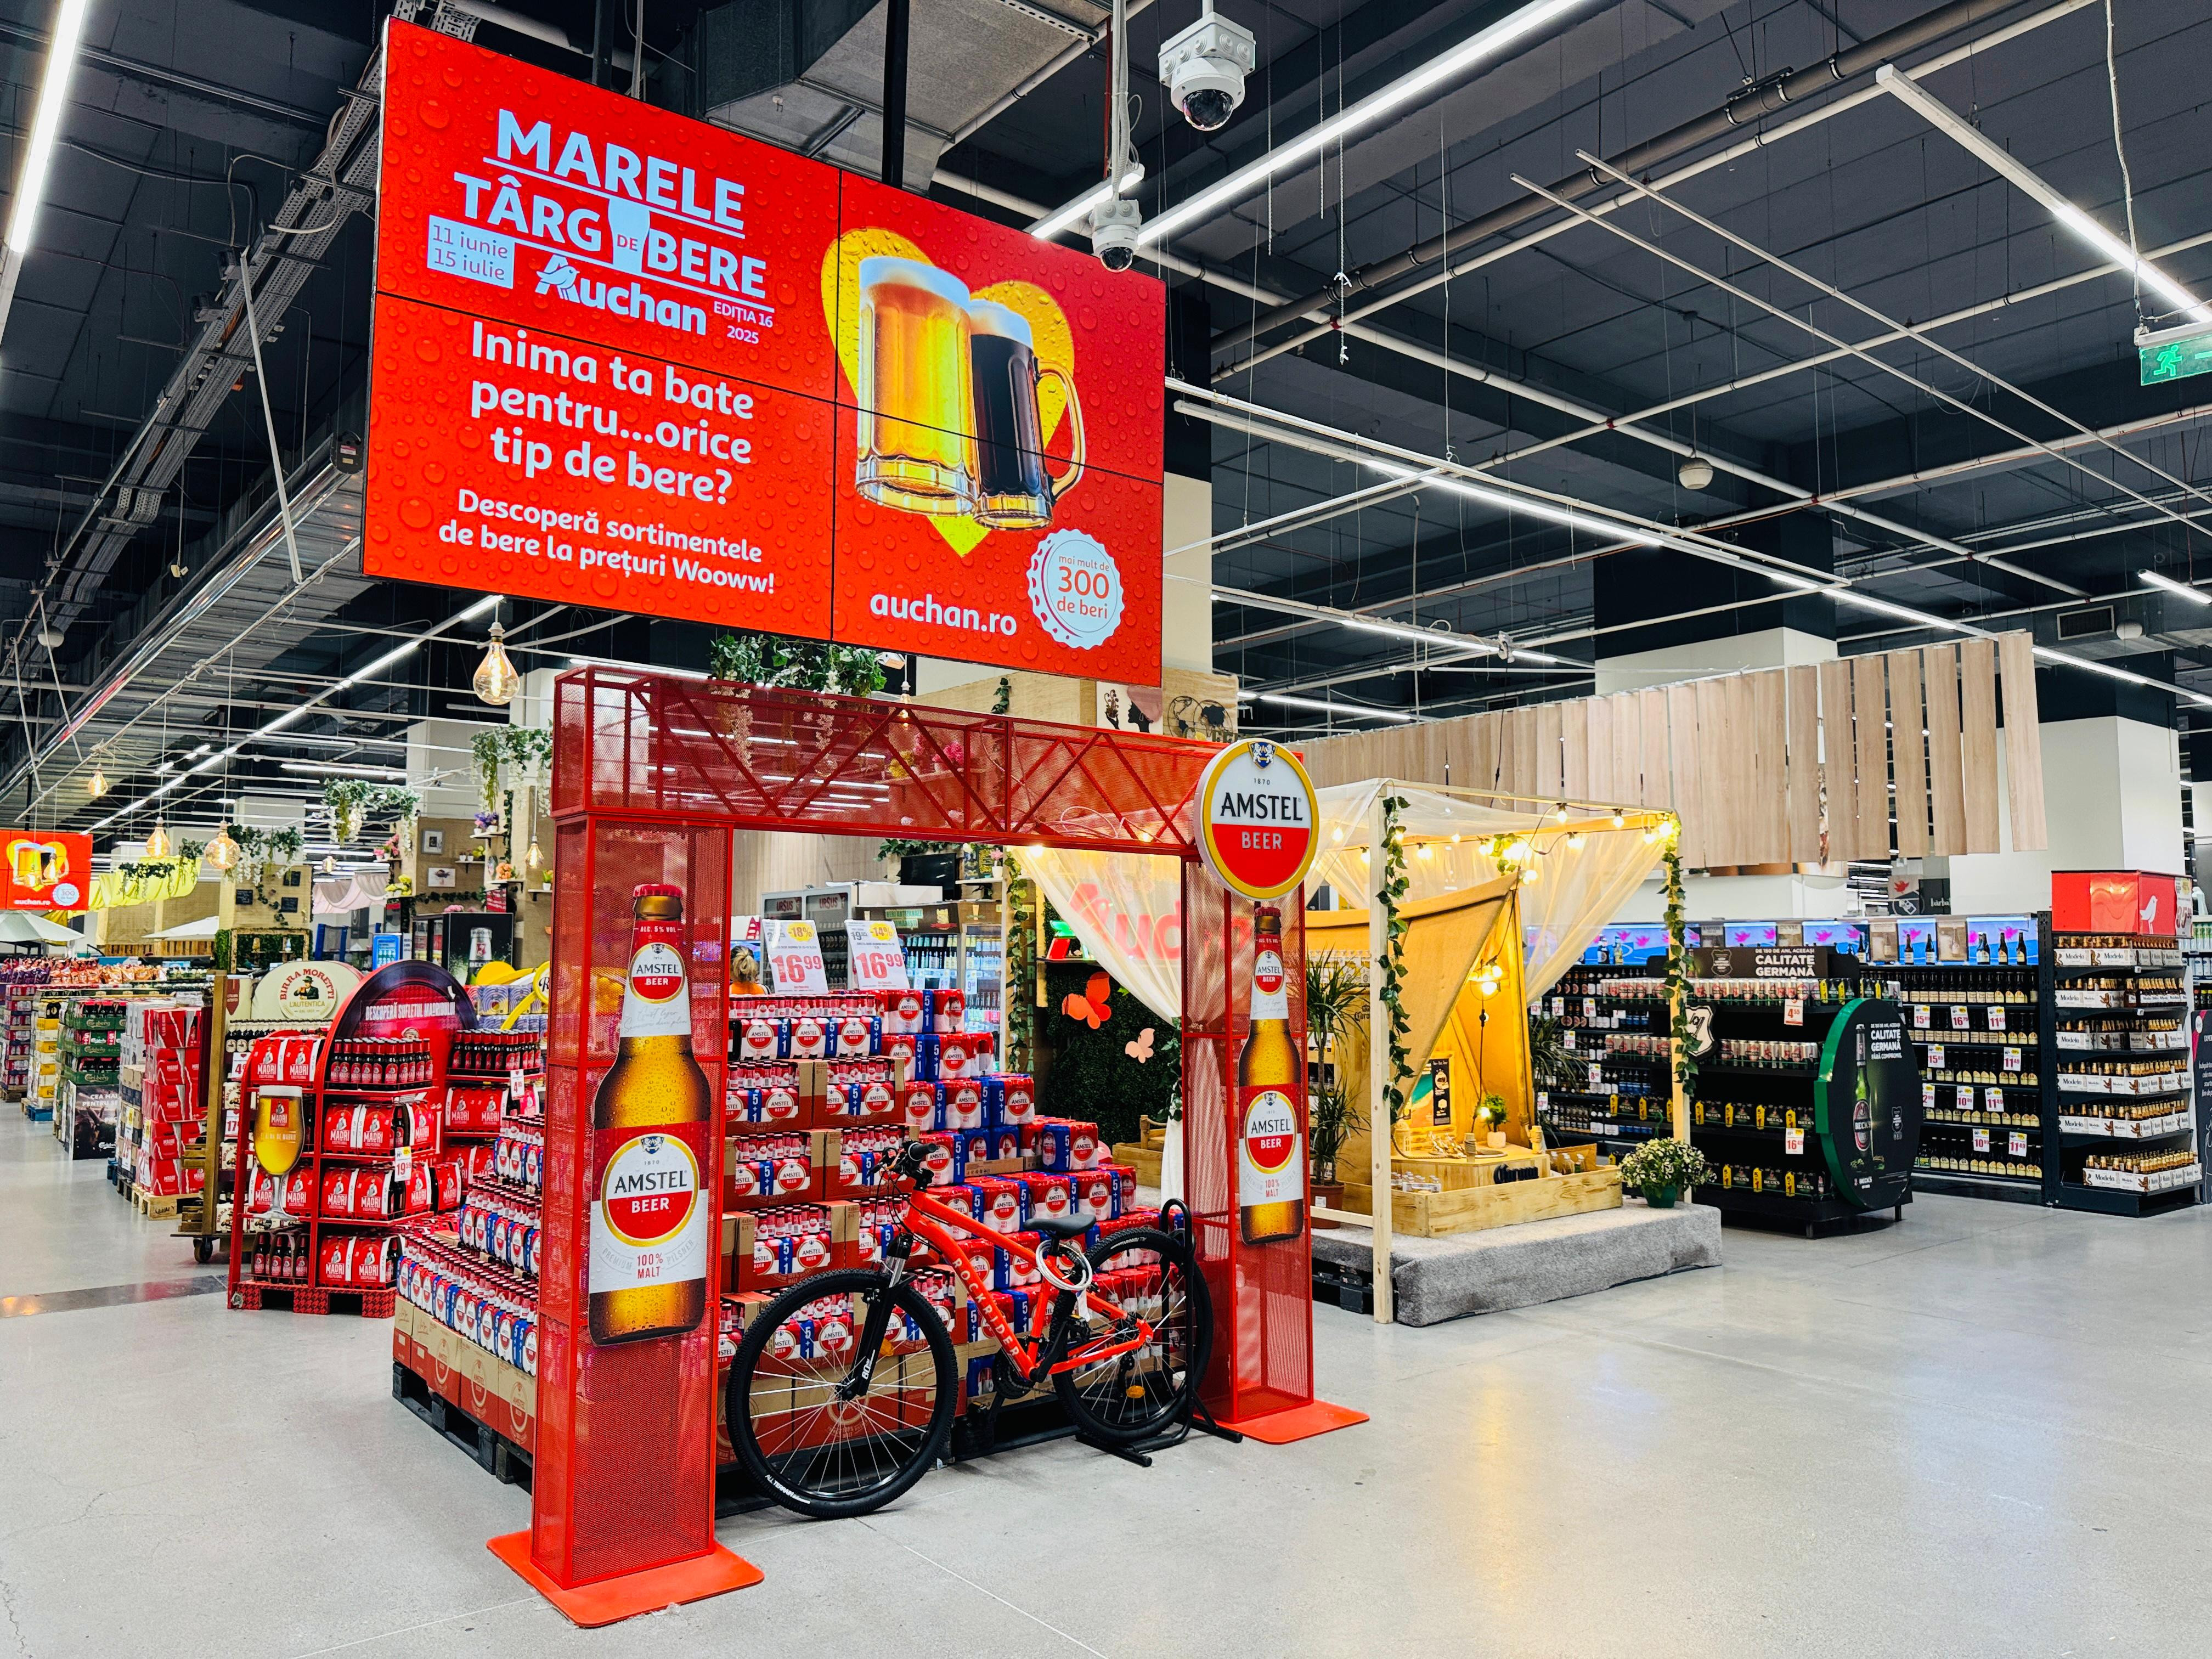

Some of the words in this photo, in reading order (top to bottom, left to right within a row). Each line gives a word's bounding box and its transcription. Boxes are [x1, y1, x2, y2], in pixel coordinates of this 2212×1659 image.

[497, 109, 744, 230] MARELE
[433, 224, 453, 242] 11
[459, 230, 508, 259] iunie
[454, 172, 601, 252] TÂRG
[618, 234, 638, 252] DE
[648, 228, 766, 298] BERE
[434, 247, 456, 267] 15
[461, 251, 505, 281] iulie
[536, 254, 706, 335] Auchan
[759, 312, 773, 328] 16
[727, 325, 759, 344] 2025
[473, 321, 596, 383] Inima
[610, 356, 652, 396] ta
[666, 366, 753, 420] bate
[490, 426, 552, 478] tip
[564, 441, 615, 482] de
[628, 451, 732, 505] bere?
[459, 489, 599, 534] Descoperă
[607, 521, 761, 563] sortimentele
[439, 519, 473, 545] de
[481, 524, 539, 555] bere
[547, 535, 572, 561] la
[580, 549, 666, 578] prețuri
[672, 558, 775, 593] Wooww!
[1058, 555, 1075, 565] mai
[1077, 558, 1098, 568] mult
[1099, 562, 1109, 572] de
[1058, 566, 1109, 600] 300
[870, 593, 1018, 636] auchan.ro
[1057, 597, 1076, 614] de
[1079, 599, 1108, 619] beri
[1220, 792, 1303, 821] AMSTEL
[1242, 831, 1282, 850] BEER
[777, 900, 793, 911] URSUS
[819, 897, 838, 910] URSUS
[636, 964, 679, 974] AMSTEL
[1756, 955, 1815, 965] CALITATE
[1257, 966, 1281, 974] AMSTEL
[1756, 965, 1815, 976] GERMANĂ
[280, 970, 301, 1000] BIRRA
[303, 969, 334, 999] MORETTI
[1871, 1029, 1901, 1040] CALITATE
[1871, 1040, 1901, 1052] GERMANĂ
[1251, 1119, 1290, 1134] AMSTEL
[1260, 1138, 1282, 1149] BEER
[614, 1170, 687, 1194] AMSTEL
[1265, 1179, 1280, 1189] 100%
[1266, 1188, 1279, 1198] MALT
[631, 1197, 670, 1214] BEER
[637, 1252, 663, 1266] 100%
[637, 1266, 661, 1279] MALT
[952, 1258, 1020, 1356] ROCKRIDER
